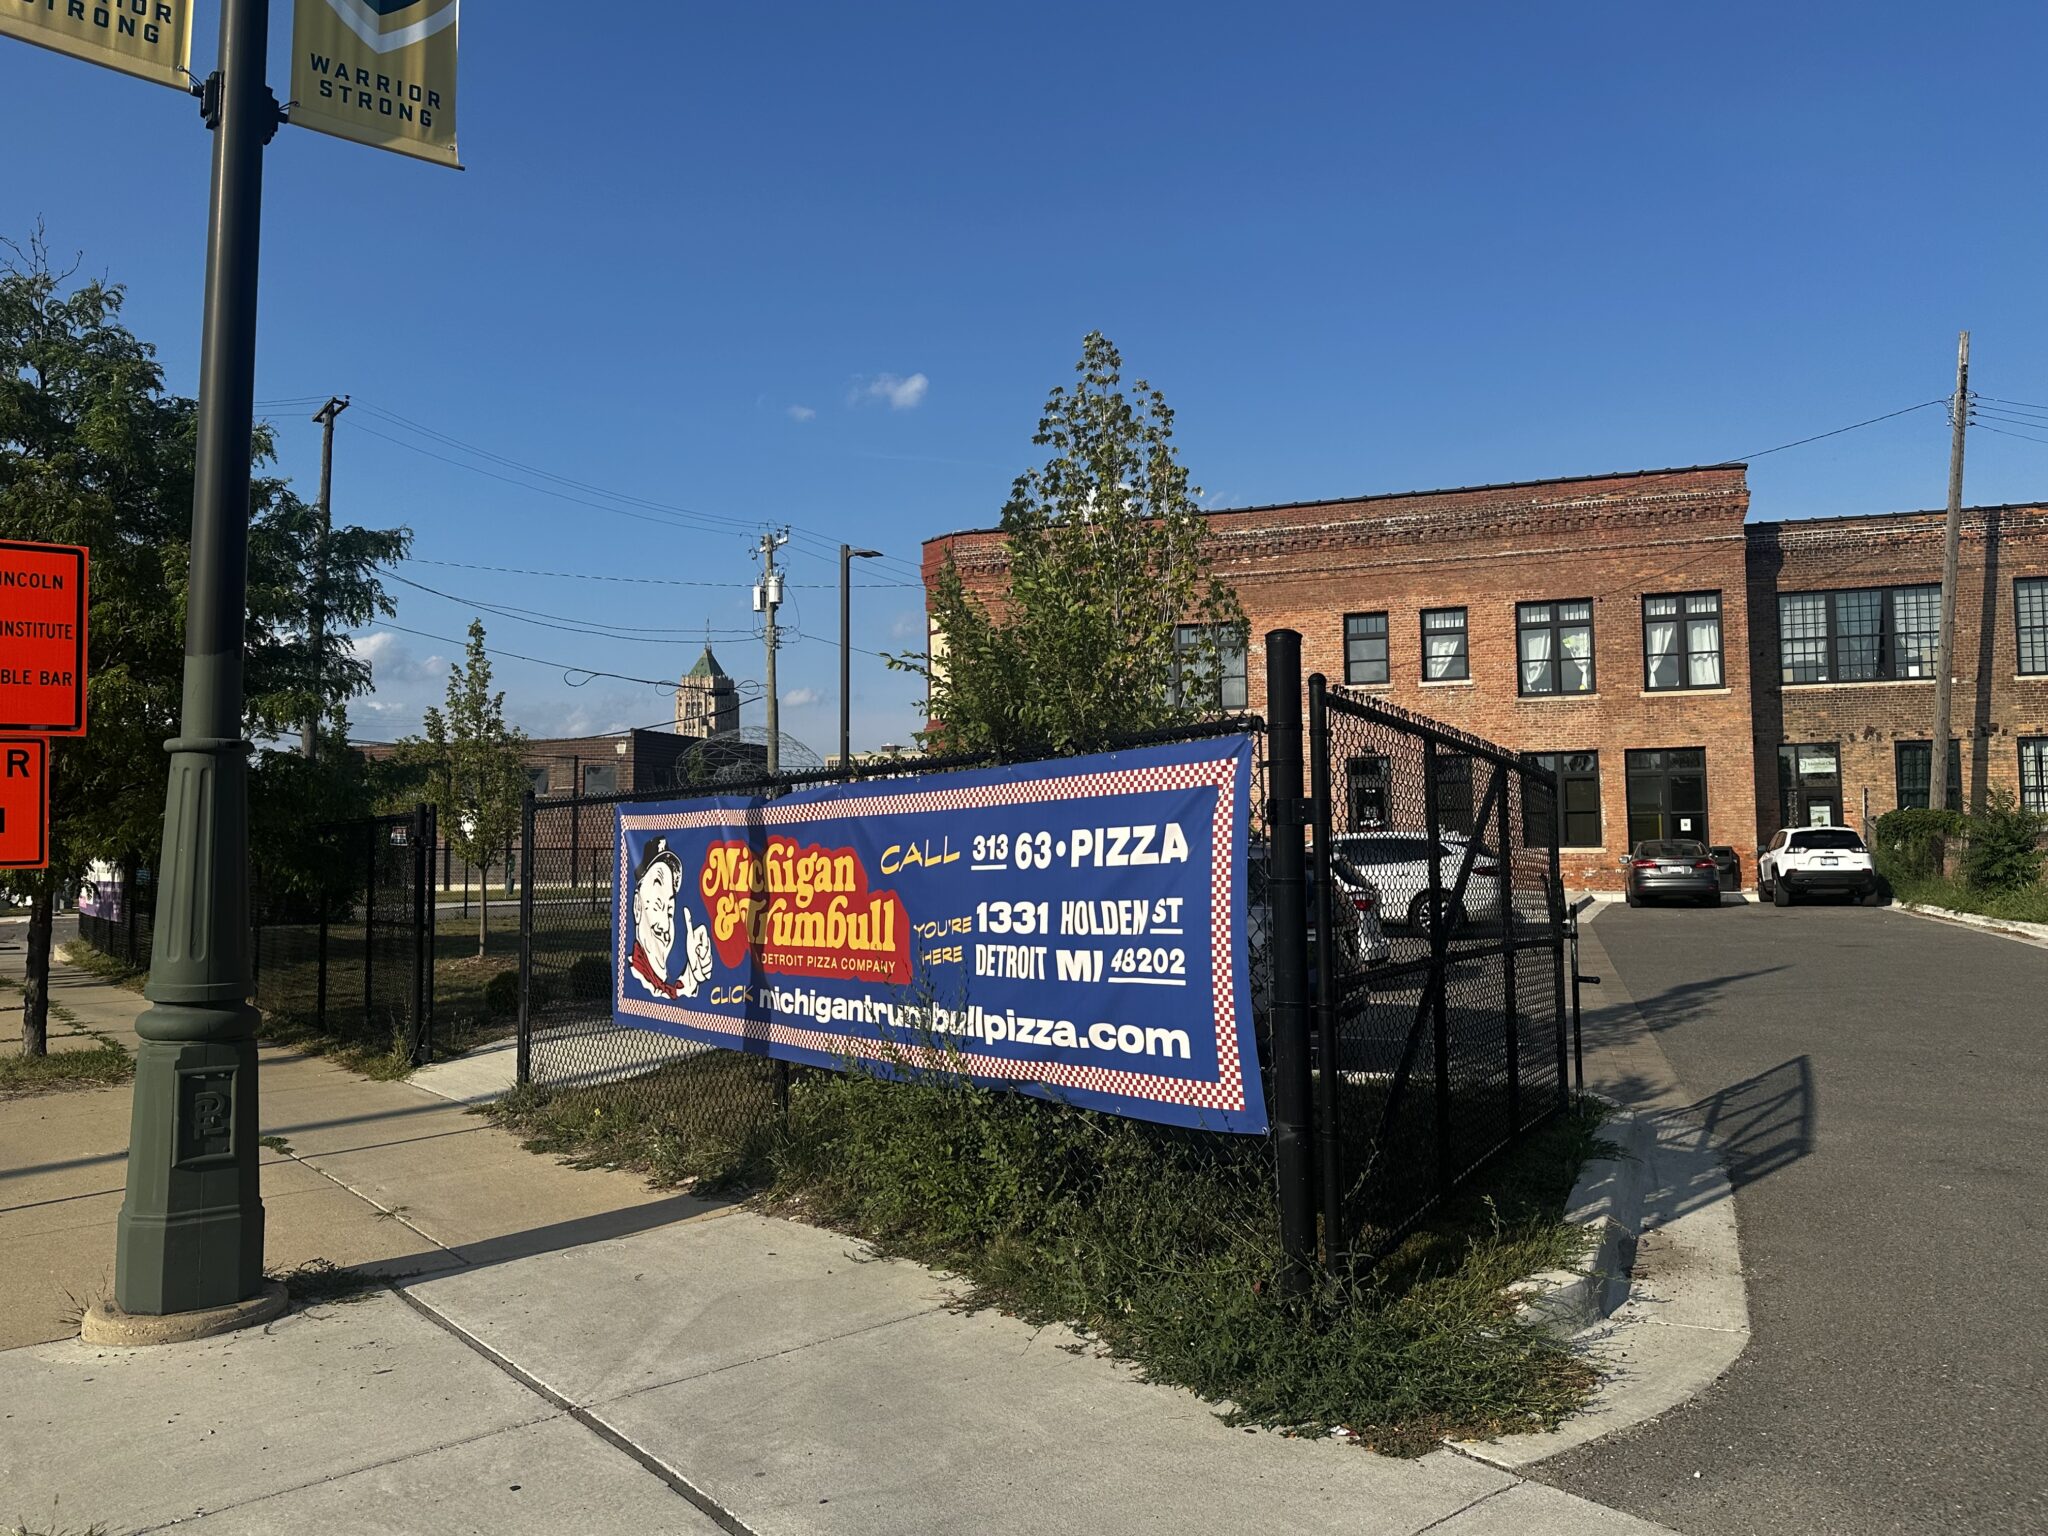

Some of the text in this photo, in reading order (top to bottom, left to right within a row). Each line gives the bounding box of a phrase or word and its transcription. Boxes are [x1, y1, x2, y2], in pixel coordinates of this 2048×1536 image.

[311, 53, 440, 110] WARRIOR
[320, 79, 431, 127] STRONG
[0, 621, 73, 640] INSTITUTE
[40, 671, 72, 687] BAR
[881, 835, 960, 875] CALL
[972, 833, 1008, 861] 313
[702, 843, 856, 908] Michigan
[738, 895, 896, 952] Trumbull
[913, 897, 1183, 939] YOU'RE 1331 HOLDEN ST
[761, 953, 896, 974] DETROIT PIZZA COMPANY
[922, 944, 1185, 982] HERE DETROIT MI 48202
[710, 984, 754, 1005] CLICK
